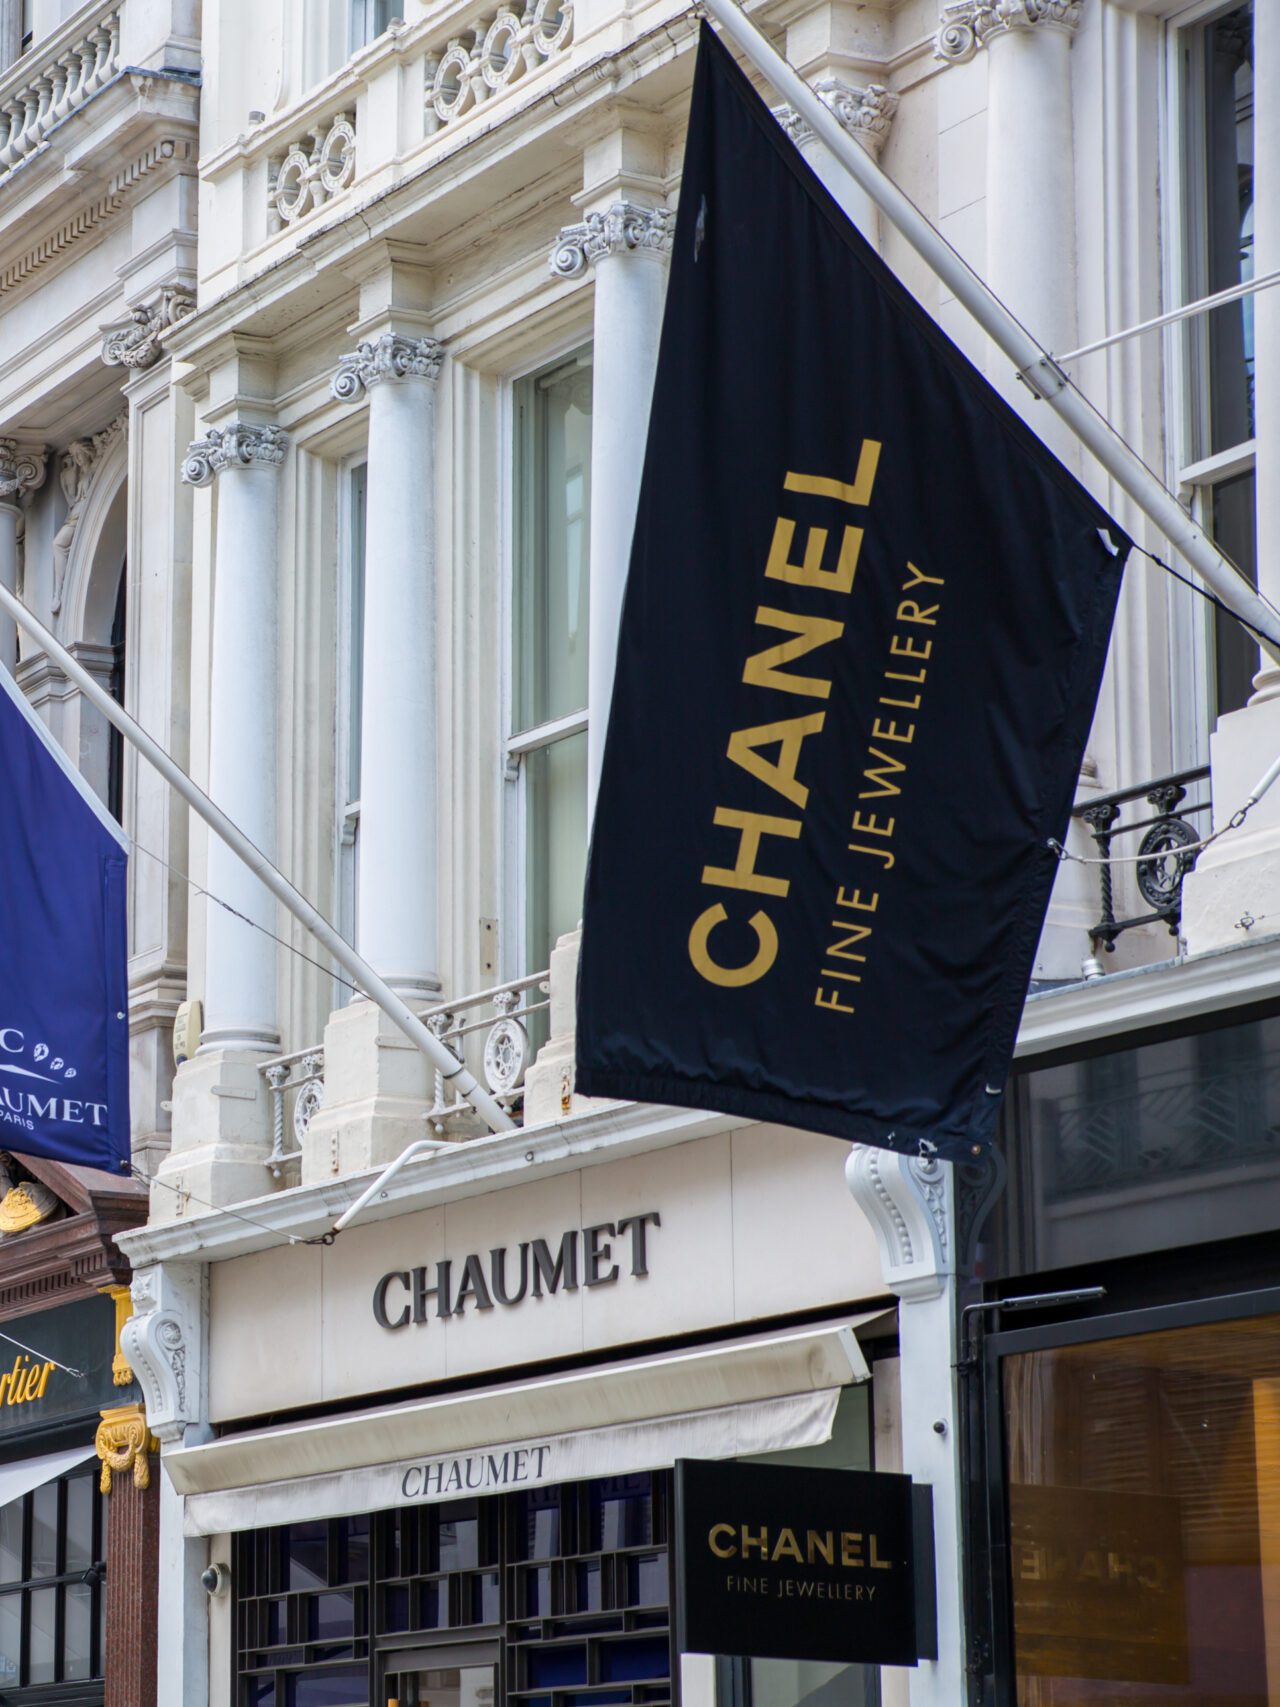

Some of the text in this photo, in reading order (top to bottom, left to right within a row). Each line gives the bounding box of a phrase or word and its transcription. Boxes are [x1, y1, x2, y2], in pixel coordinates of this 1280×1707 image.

[688, 439, 882, 989] CHANEL
[814, 560, 945, 1014] FINE JEWELLERY
[372, 1211, 662, 1330] CHAUMET
[401, 1445, 551, 1497] CHAUMET
[708, 1523, 892, 1569] CHANEL
[726, 1575, 877, 1601] FINE JEWELLERY
